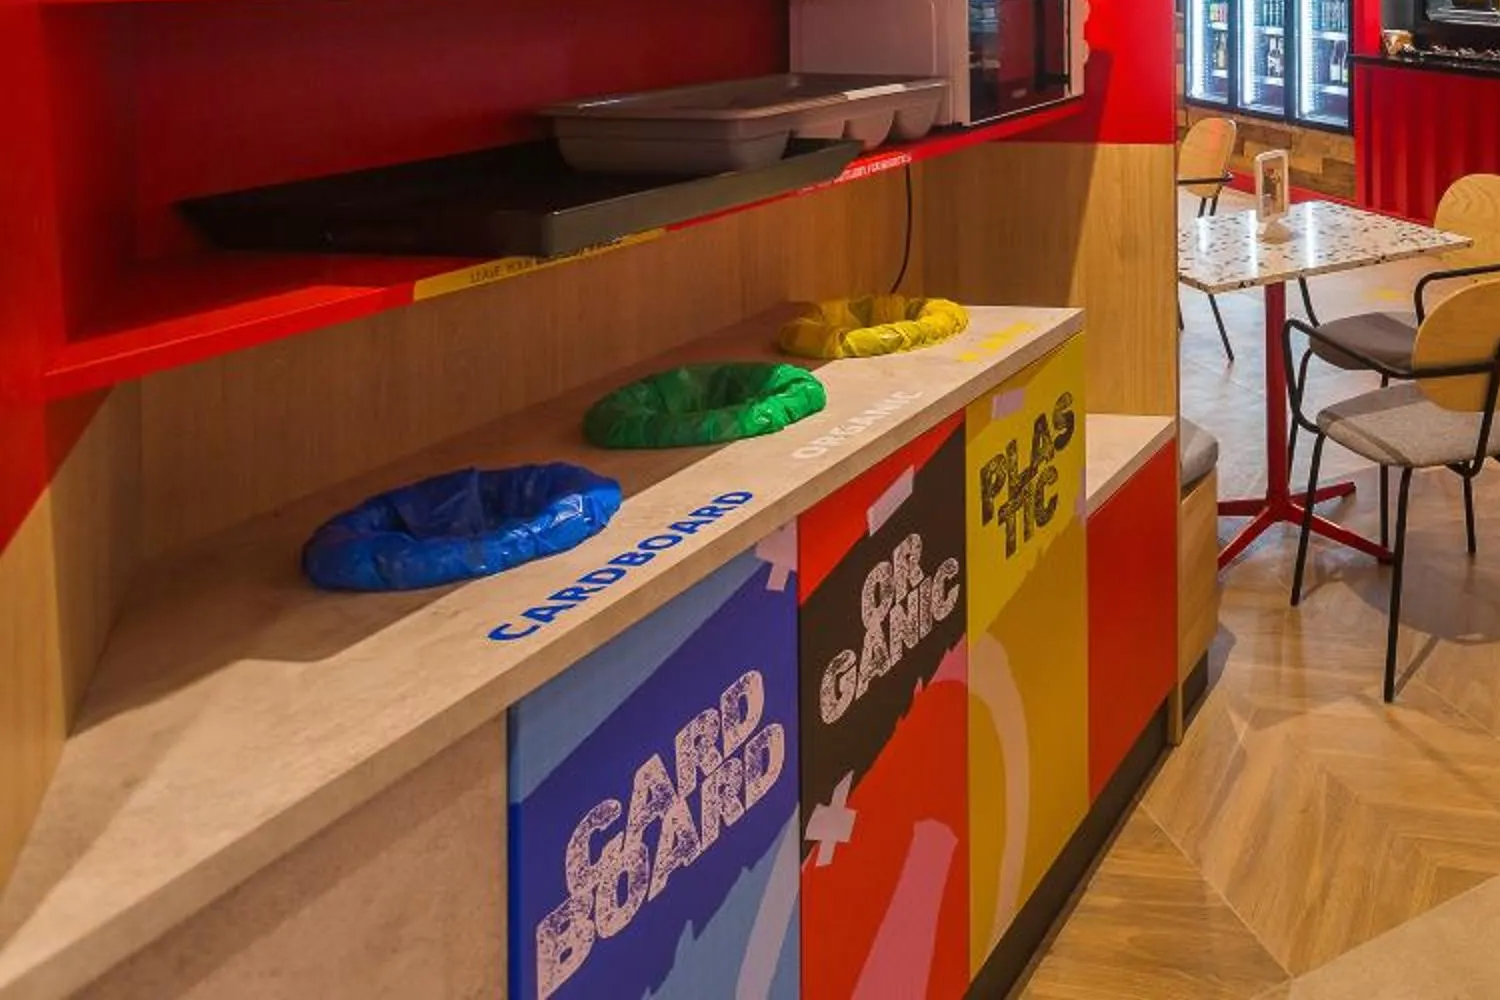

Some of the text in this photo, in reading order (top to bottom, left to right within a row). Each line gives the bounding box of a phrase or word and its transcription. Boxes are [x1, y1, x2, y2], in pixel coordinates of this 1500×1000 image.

[980, 391, 1075, 527] PLAS
[998, 465, 1059, 560] TIC
[488, 489, 753, 642] CARDBOARD
[820, 557, 960, 724] GANIC
[861, 533, 923, 626] OR
[566, 669, 765, 900] CARD
[536, 723, 785, 1000] BOARD
